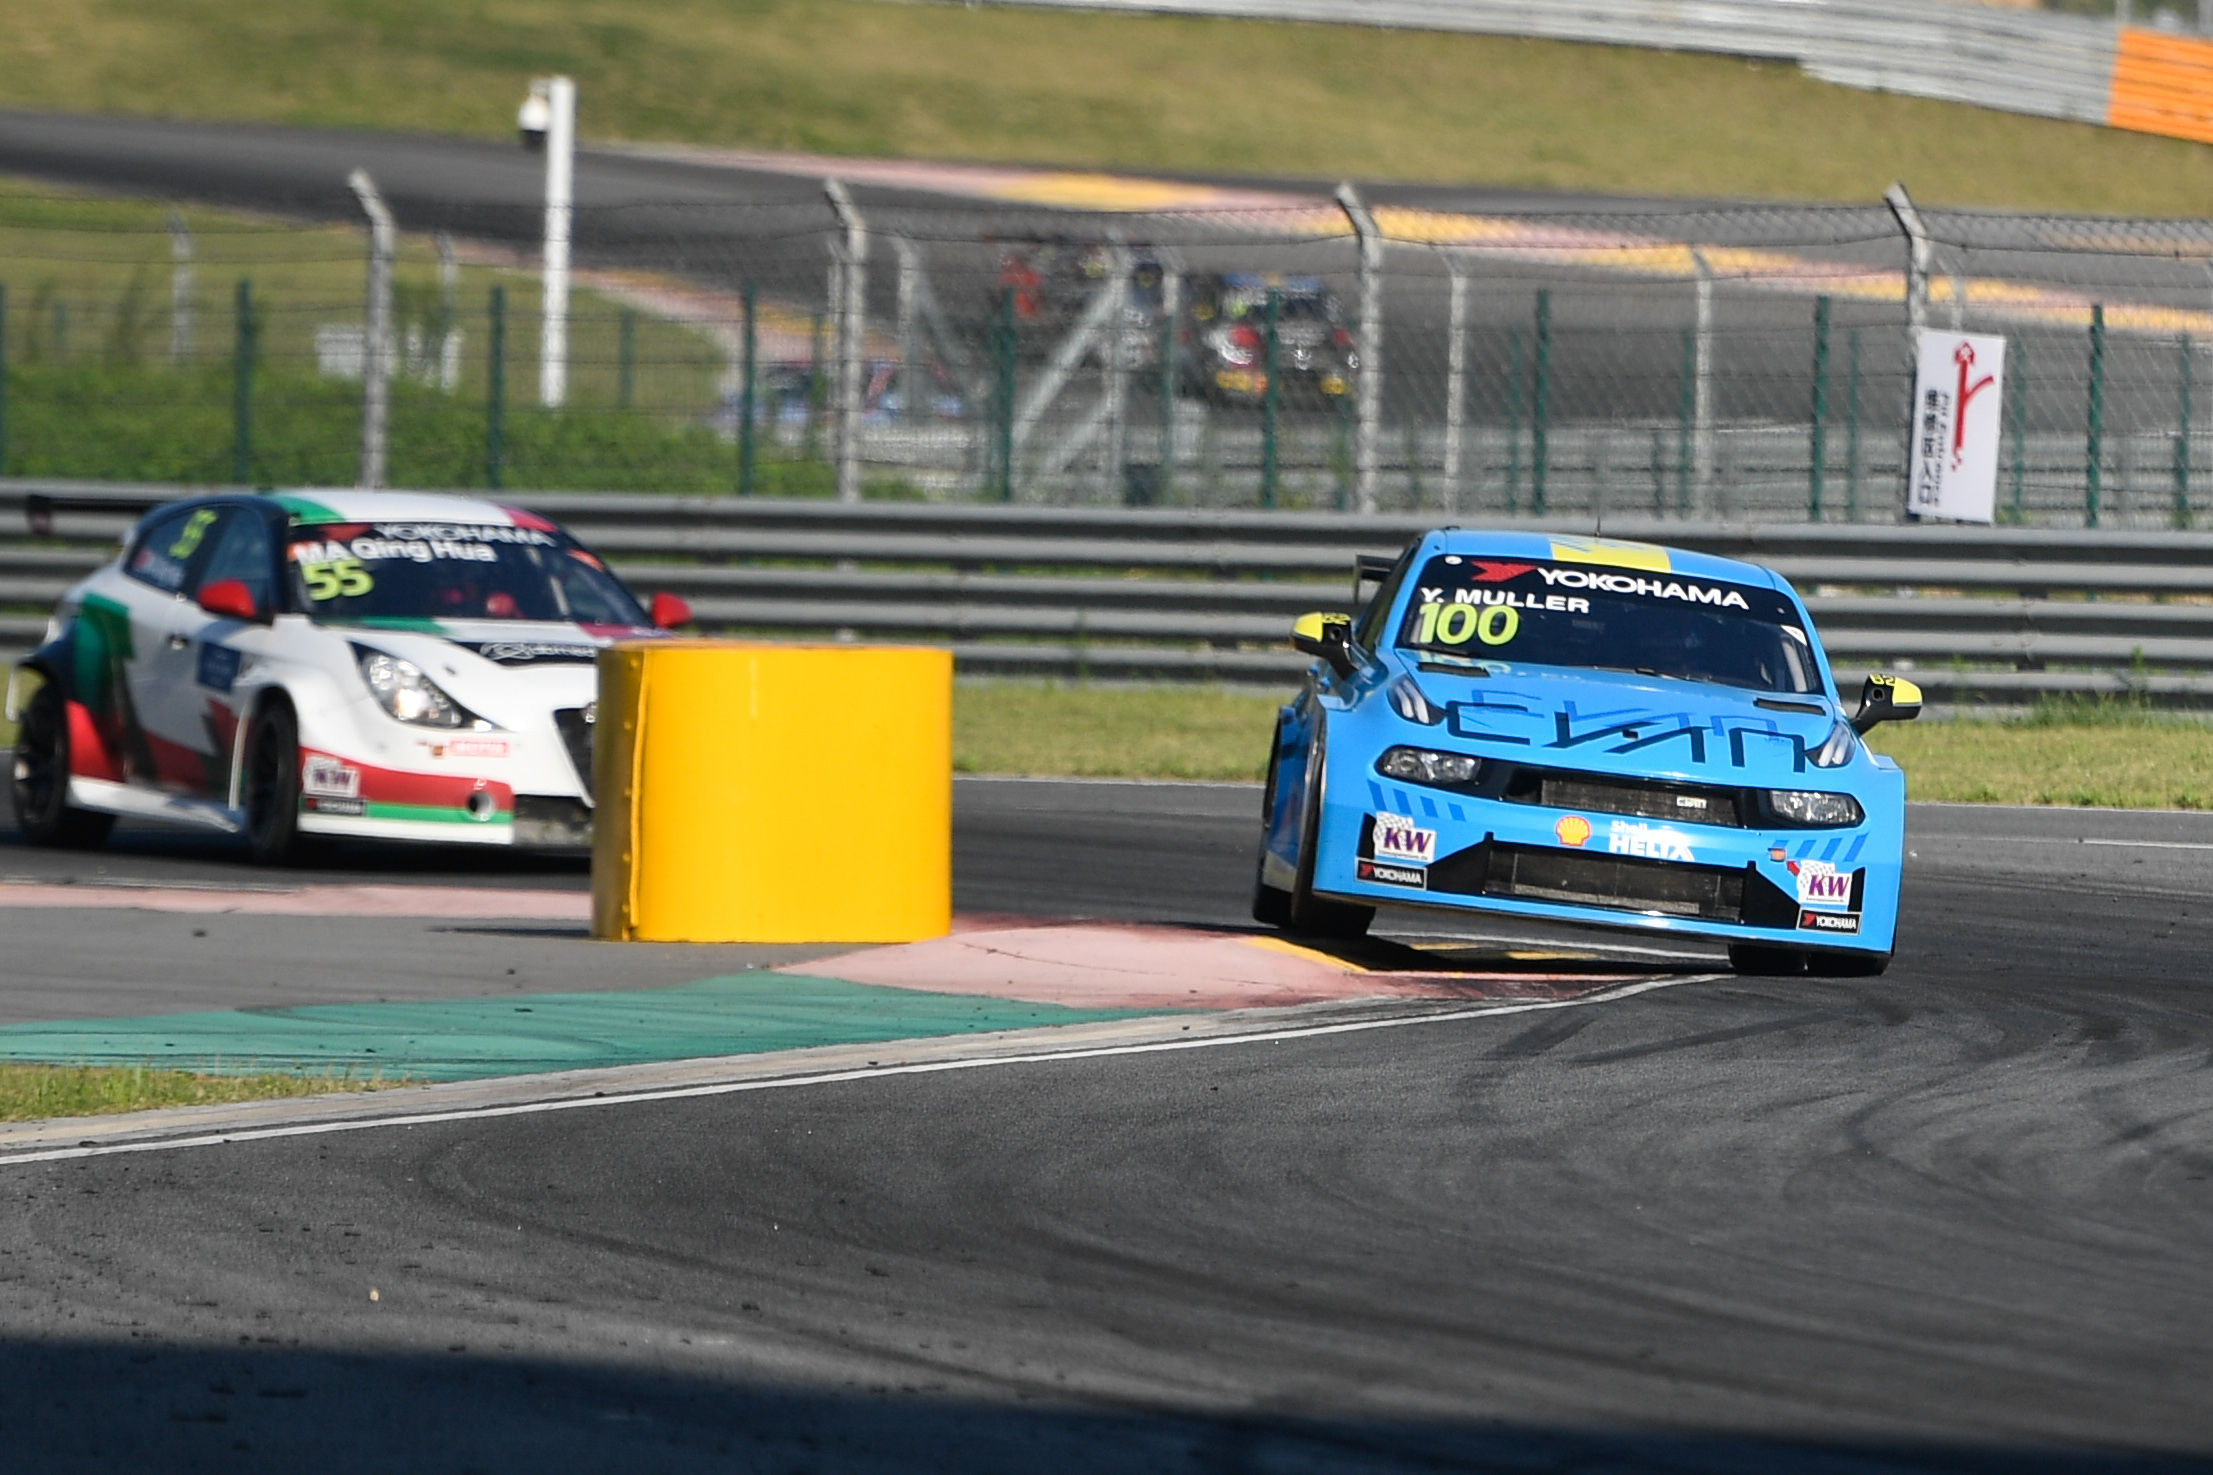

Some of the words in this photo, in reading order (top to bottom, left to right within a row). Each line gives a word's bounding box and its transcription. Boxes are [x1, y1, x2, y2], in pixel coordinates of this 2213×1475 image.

[373, 522, 557, 549] YOKOHAMA
[295, 539, 350, 565] MA
[351, 537, 432, 564] Qing
[435, 539, 497, 564] Hua
[303, 558, 374, 601] 55
[1537, 566, 1750, 610] YOKOHAMA
[1420, 586, 1445, 604] Y.
[1454, 589, 1590, 614] MULLER
[1418, 603, 1520, 646] 100
[1384, 826, 1433, 854] KW
[1610, 820, 1649, 837] Shell
[1609, 832, 1695, 862] HELIX
[1373, 865, 1423, 884] YOKOHAMA
[1808, 874, 1850, 897] KW
[1815, 914, 1857, 930] YOKOHAMA
